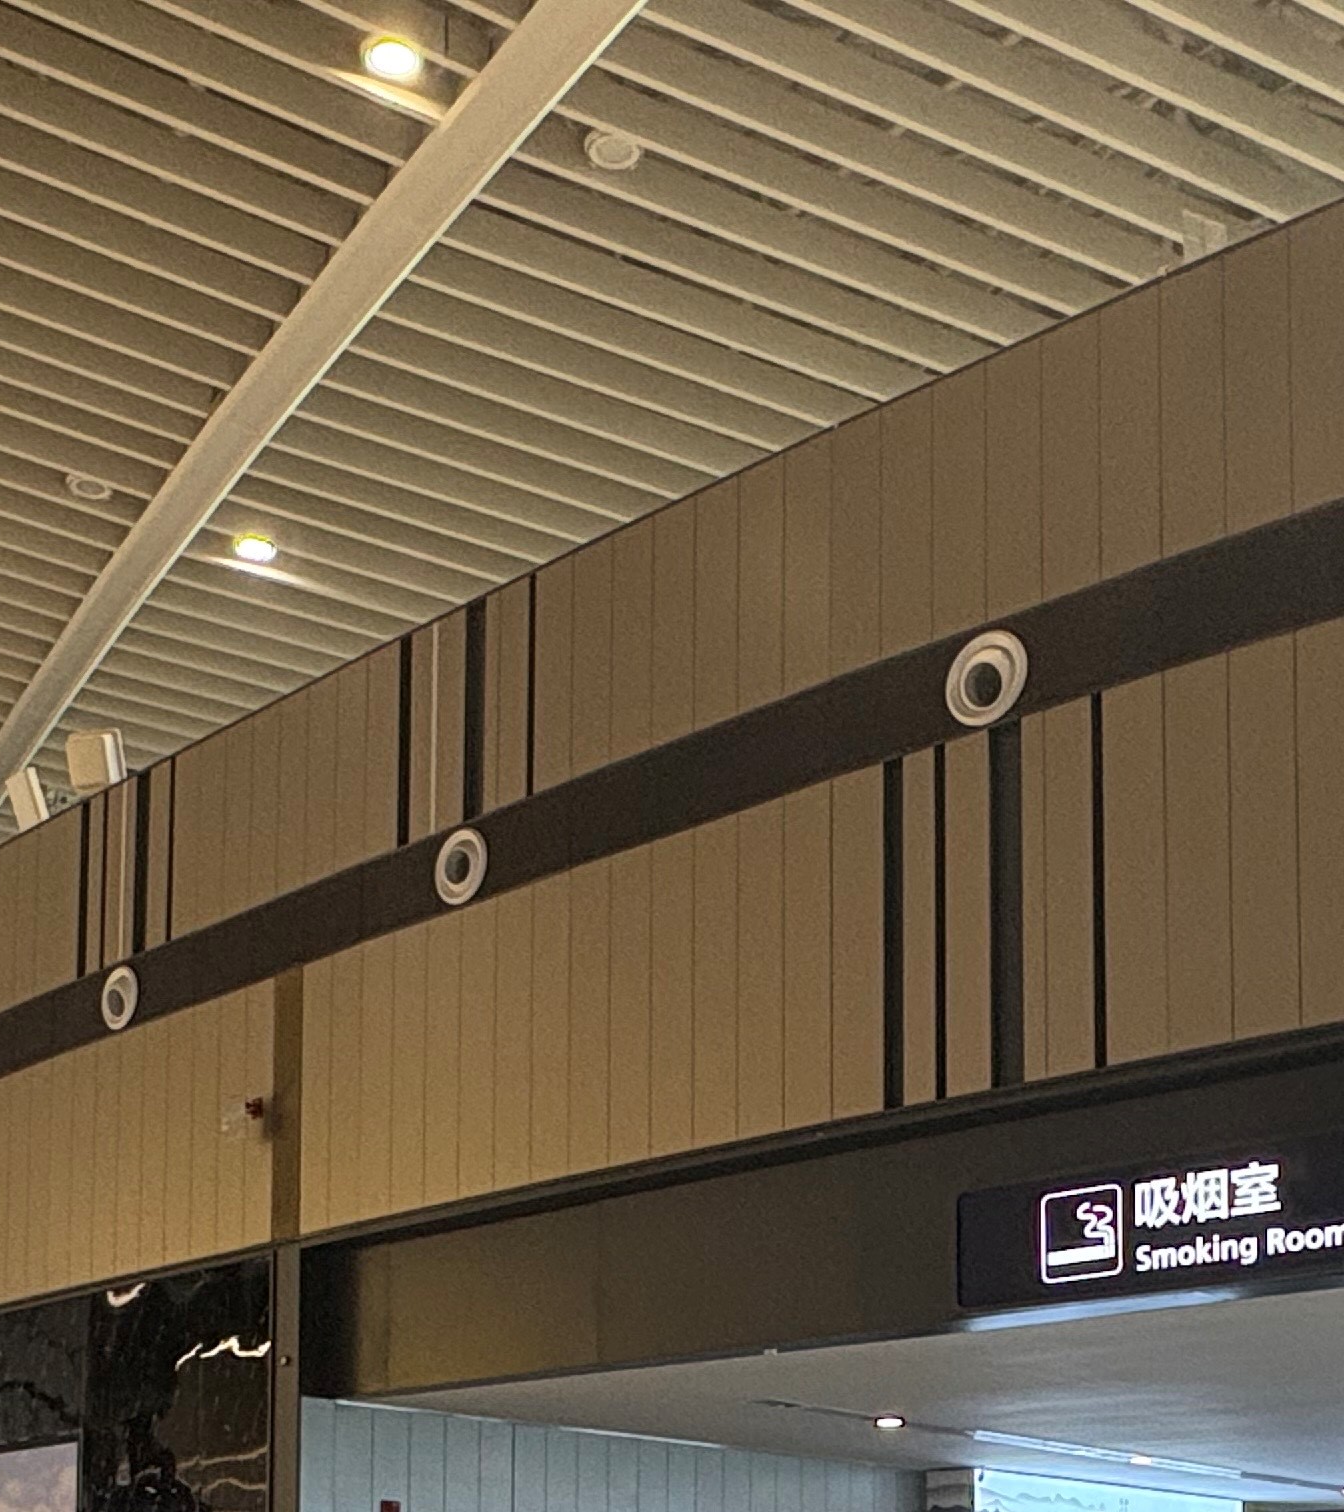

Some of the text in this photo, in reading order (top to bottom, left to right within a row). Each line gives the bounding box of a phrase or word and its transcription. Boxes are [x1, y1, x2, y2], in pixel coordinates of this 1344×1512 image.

[1134, 1160, 1282, 1229] 吸烟室
[1135, 1233, 1258, 1272] Smoking
